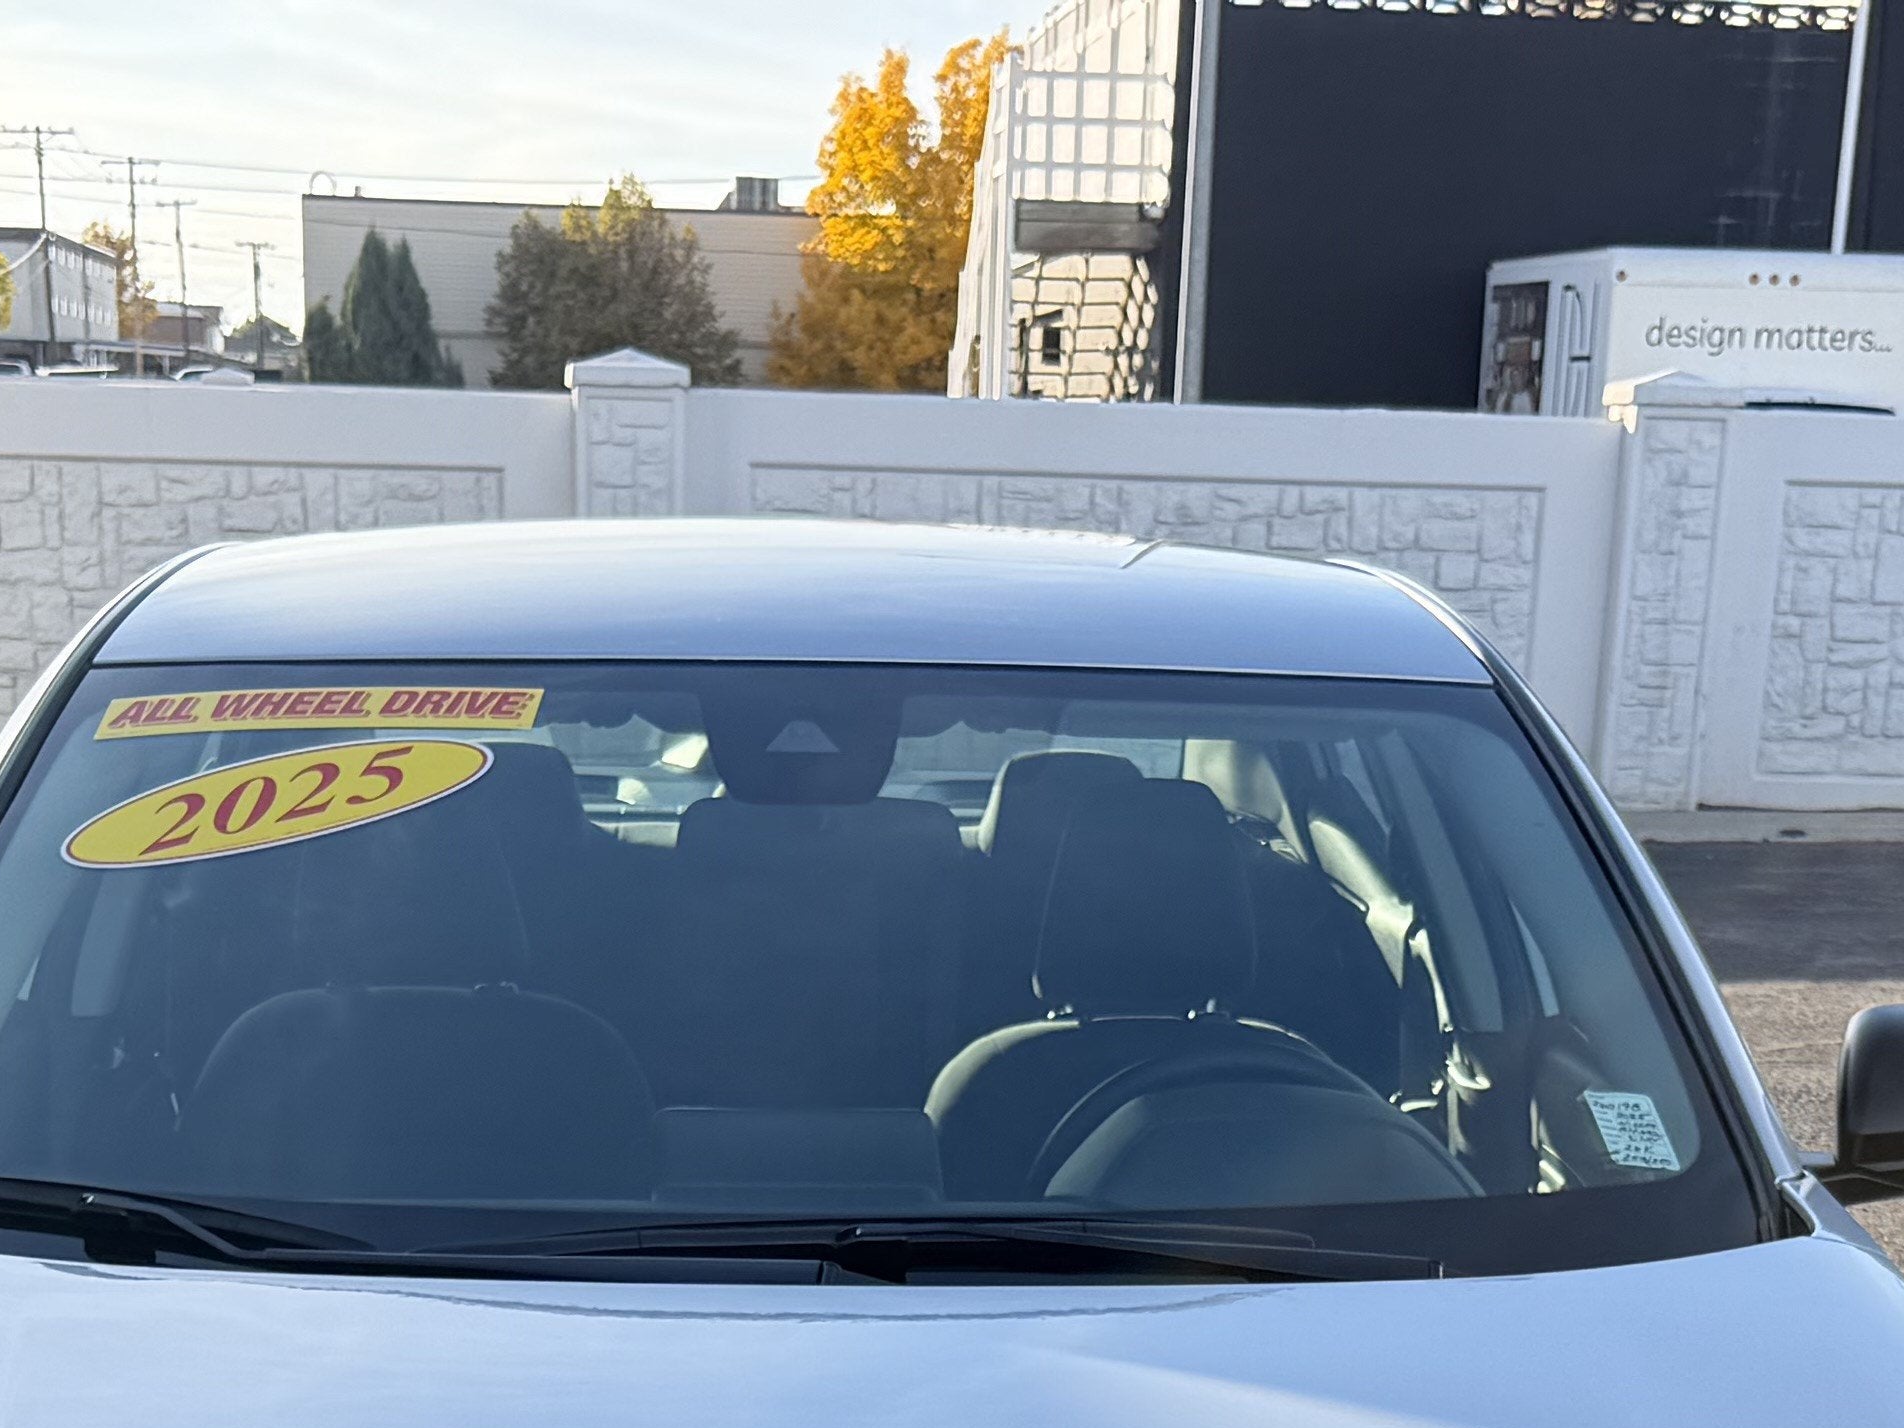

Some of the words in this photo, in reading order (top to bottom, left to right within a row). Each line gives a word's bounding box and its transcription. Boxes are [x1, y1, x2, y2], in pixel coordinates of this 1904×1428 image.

[1645, 316, 1746, 357] design
[107, 694, 200, 728] ALL
[210, 690, 374, 721] WHEEL
[379, 690, 536, 719] DRIVE
[139, 745, 415, 857] 2025
